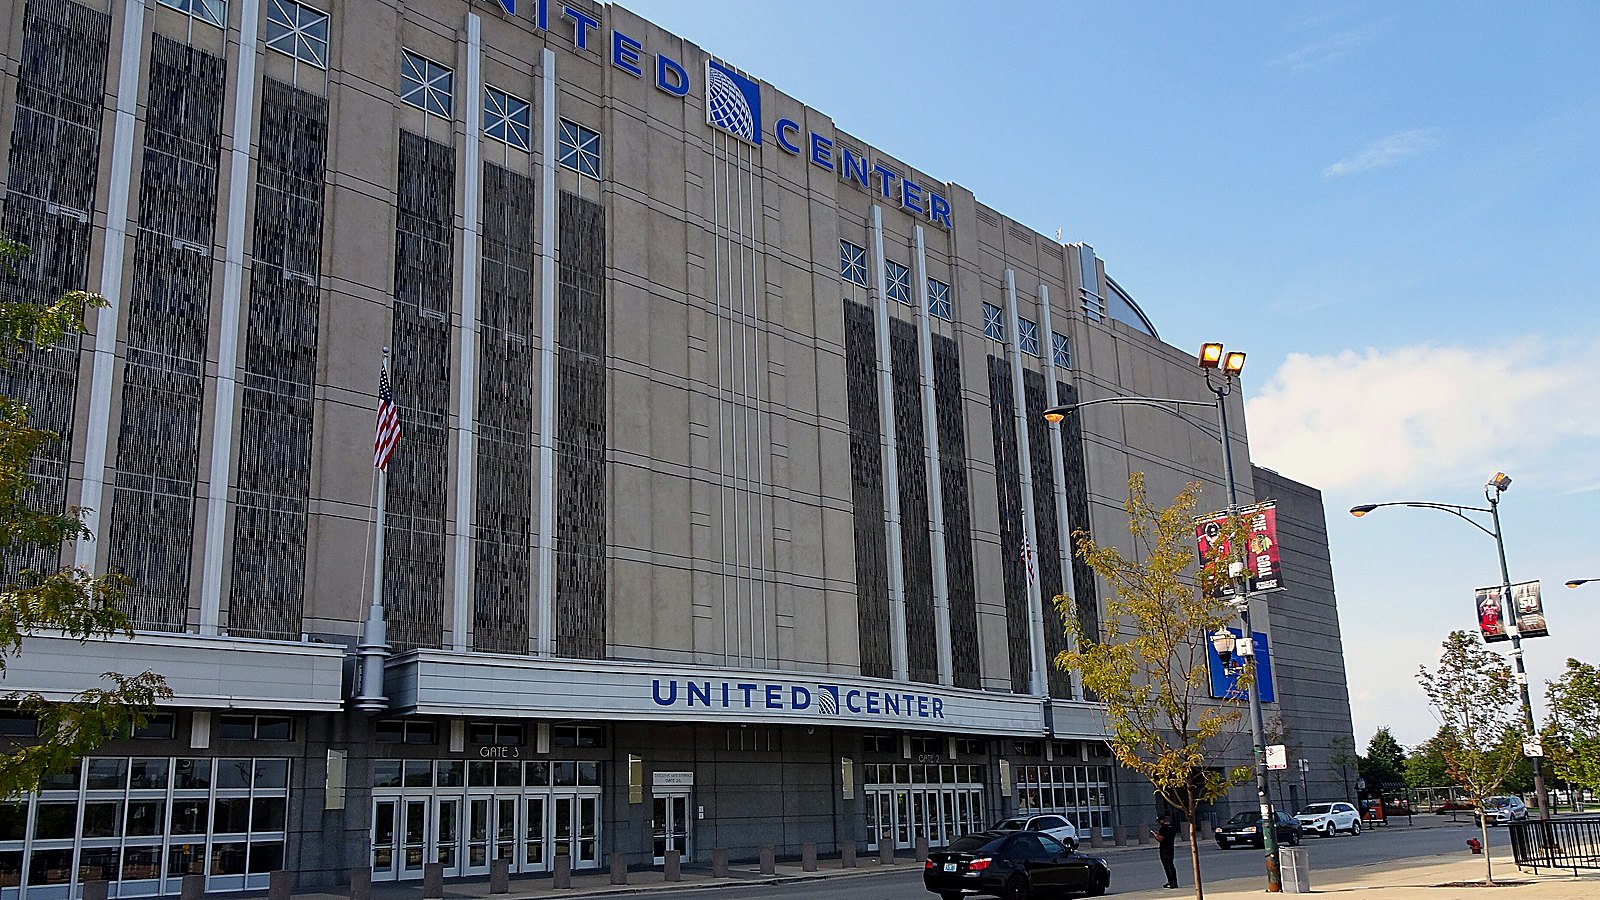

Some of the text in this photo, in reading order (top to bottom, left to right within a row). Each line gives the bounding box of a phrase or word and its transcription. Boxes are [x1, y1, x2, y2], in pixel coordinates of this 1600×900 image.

[774, 118, 953, 229] CENTER
[1256, 554, 1273, 579] GOAL
[652, 679, 945, 719] UNITED CENTER
[480, 746, 520, 758] GATE 3
[918, 754, 934, 763] GATE
